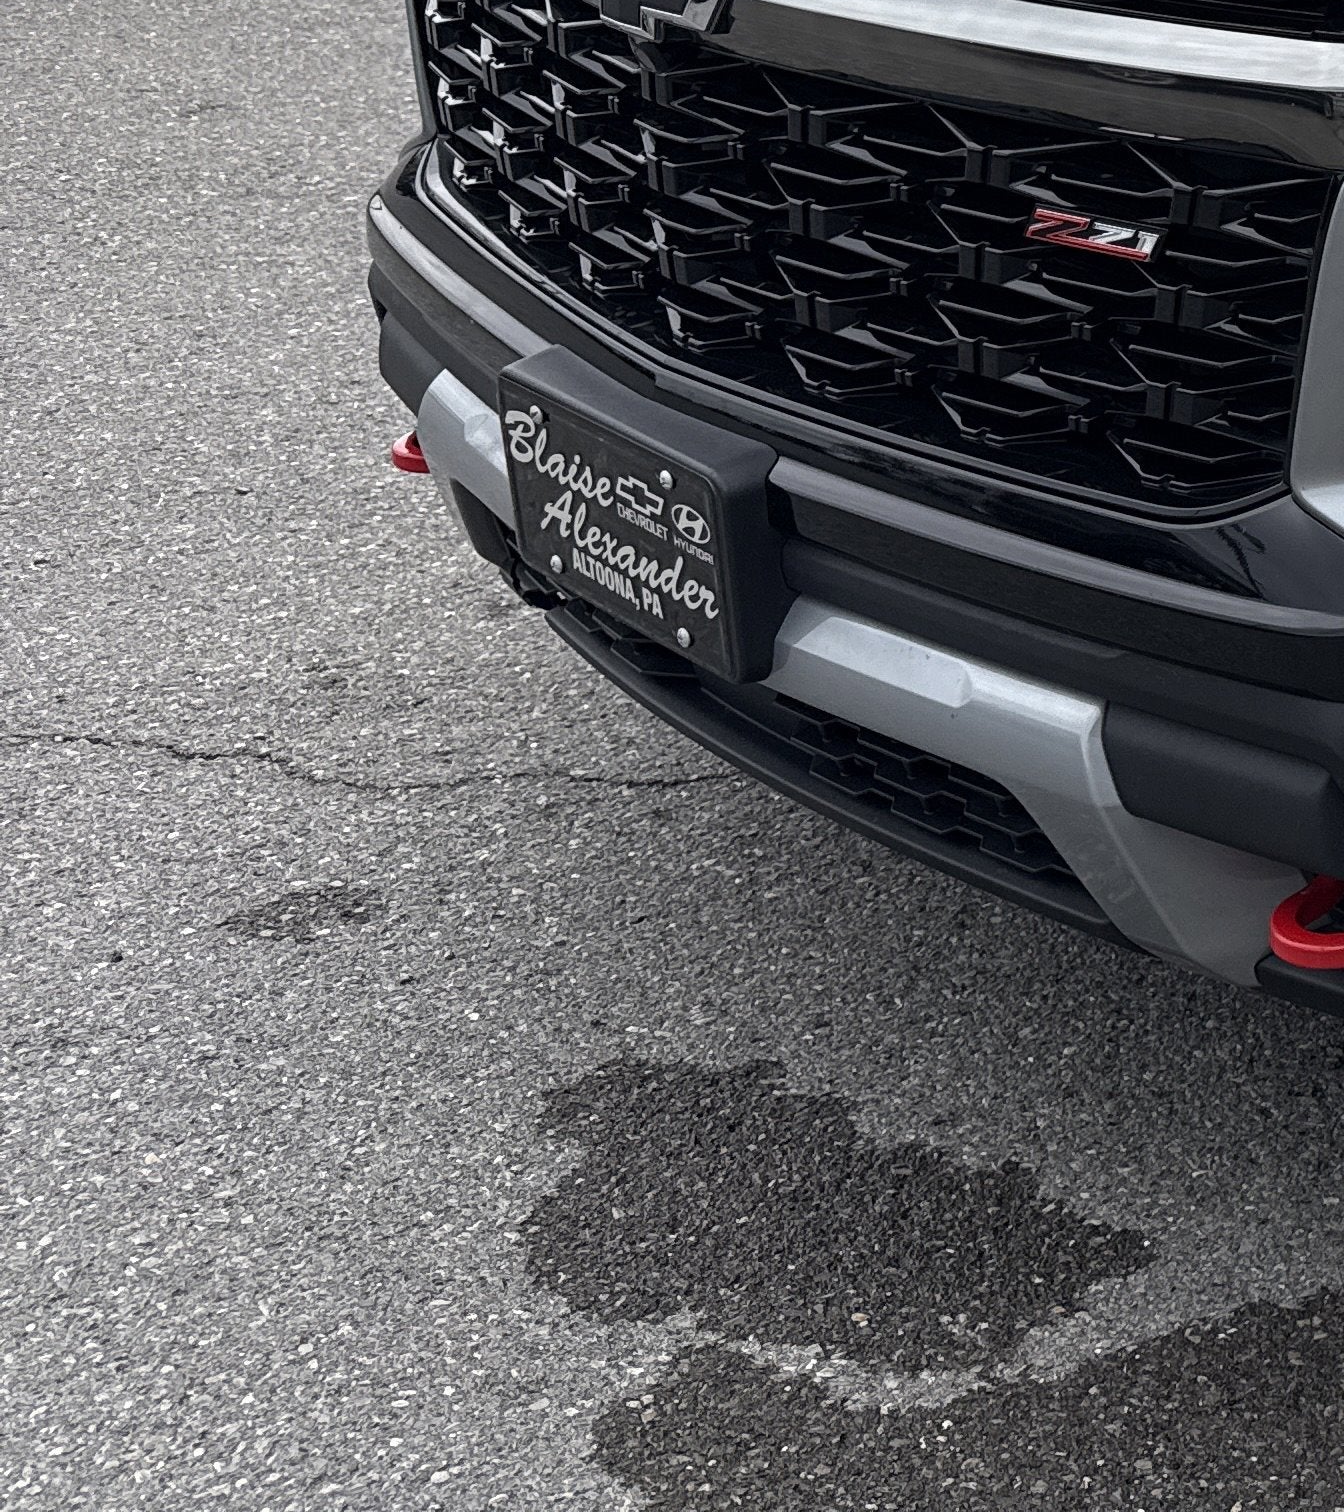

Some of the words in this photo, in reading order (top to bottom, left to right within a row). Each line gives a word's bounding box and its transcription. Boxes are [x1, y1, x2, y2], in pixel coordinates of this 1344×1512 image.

[1025, 208, 1160, 263] Z71
[505, 410, 614, 507] Blaise
[617, 502, 668, 541] CHEVROLET
[673, 535, 714, 565] HYUNDAI
[541, 491, 719, 619] Alexander
[572, 548, 641, 610] ALTOONA,
[642, 587, 664, 619] PA
